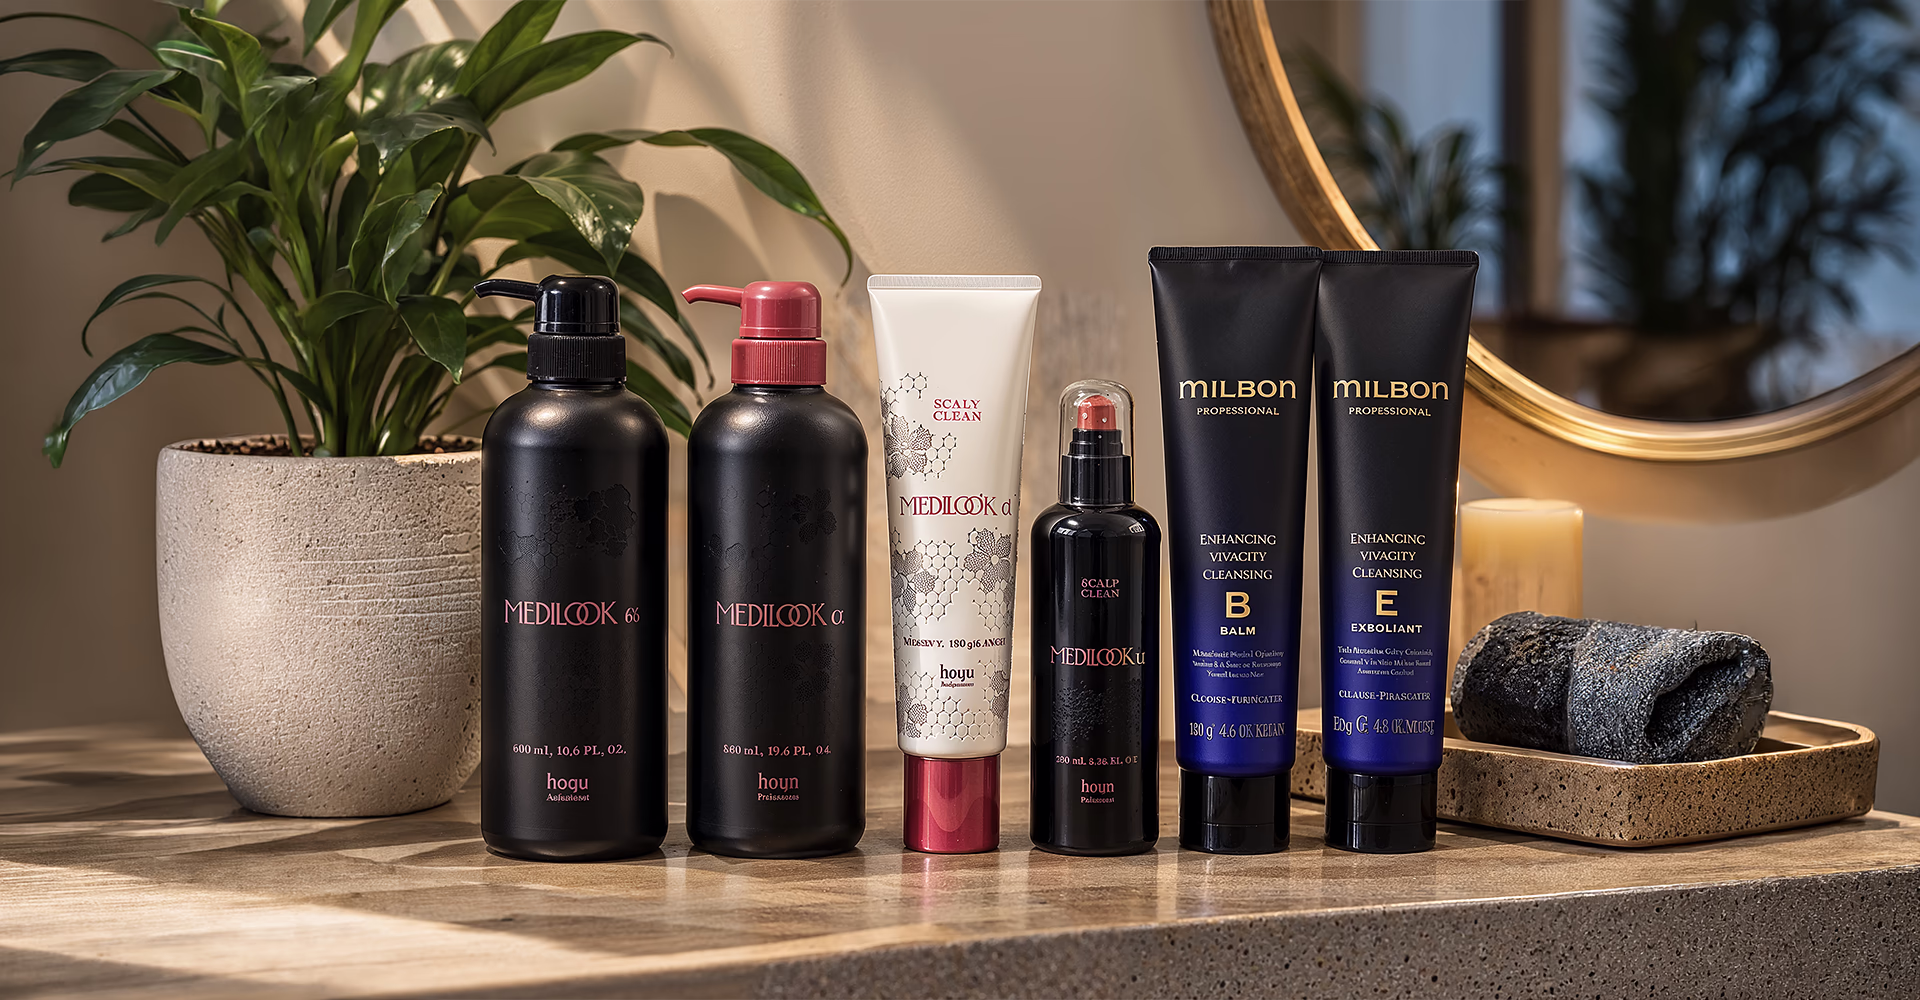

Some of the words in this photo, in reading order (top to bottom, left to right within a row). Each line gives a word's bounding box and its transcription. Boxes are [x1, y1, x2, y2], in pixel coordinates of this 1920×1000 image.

[933, 399, 980, 409] SCALY
[932, 410, 982, 421] CLEAN
[899, 495, 998, 516] MEDILOOK
[1200, 534, 1277, 546] ENHANCING
[1209, 551, 1267, 562] VIVACITY
[1202, 569, 1273, 580] CLEANSING
[1352, 566, 1423, 579] CLEANSING
[1080, 588, 1120, 598] CLEAN
[1225, 591, 1251, 618] B
[1376, 589, 1398, 616] E
[504, 599, 618, 626] MEDILOOK
[716, 600, 828, 627] MEDILOOK
[1220, 626, 1256, 636] BALM
[1350, 623, 1423, 633] EXBOLIANT
[512, 743, 531, 754] 600
